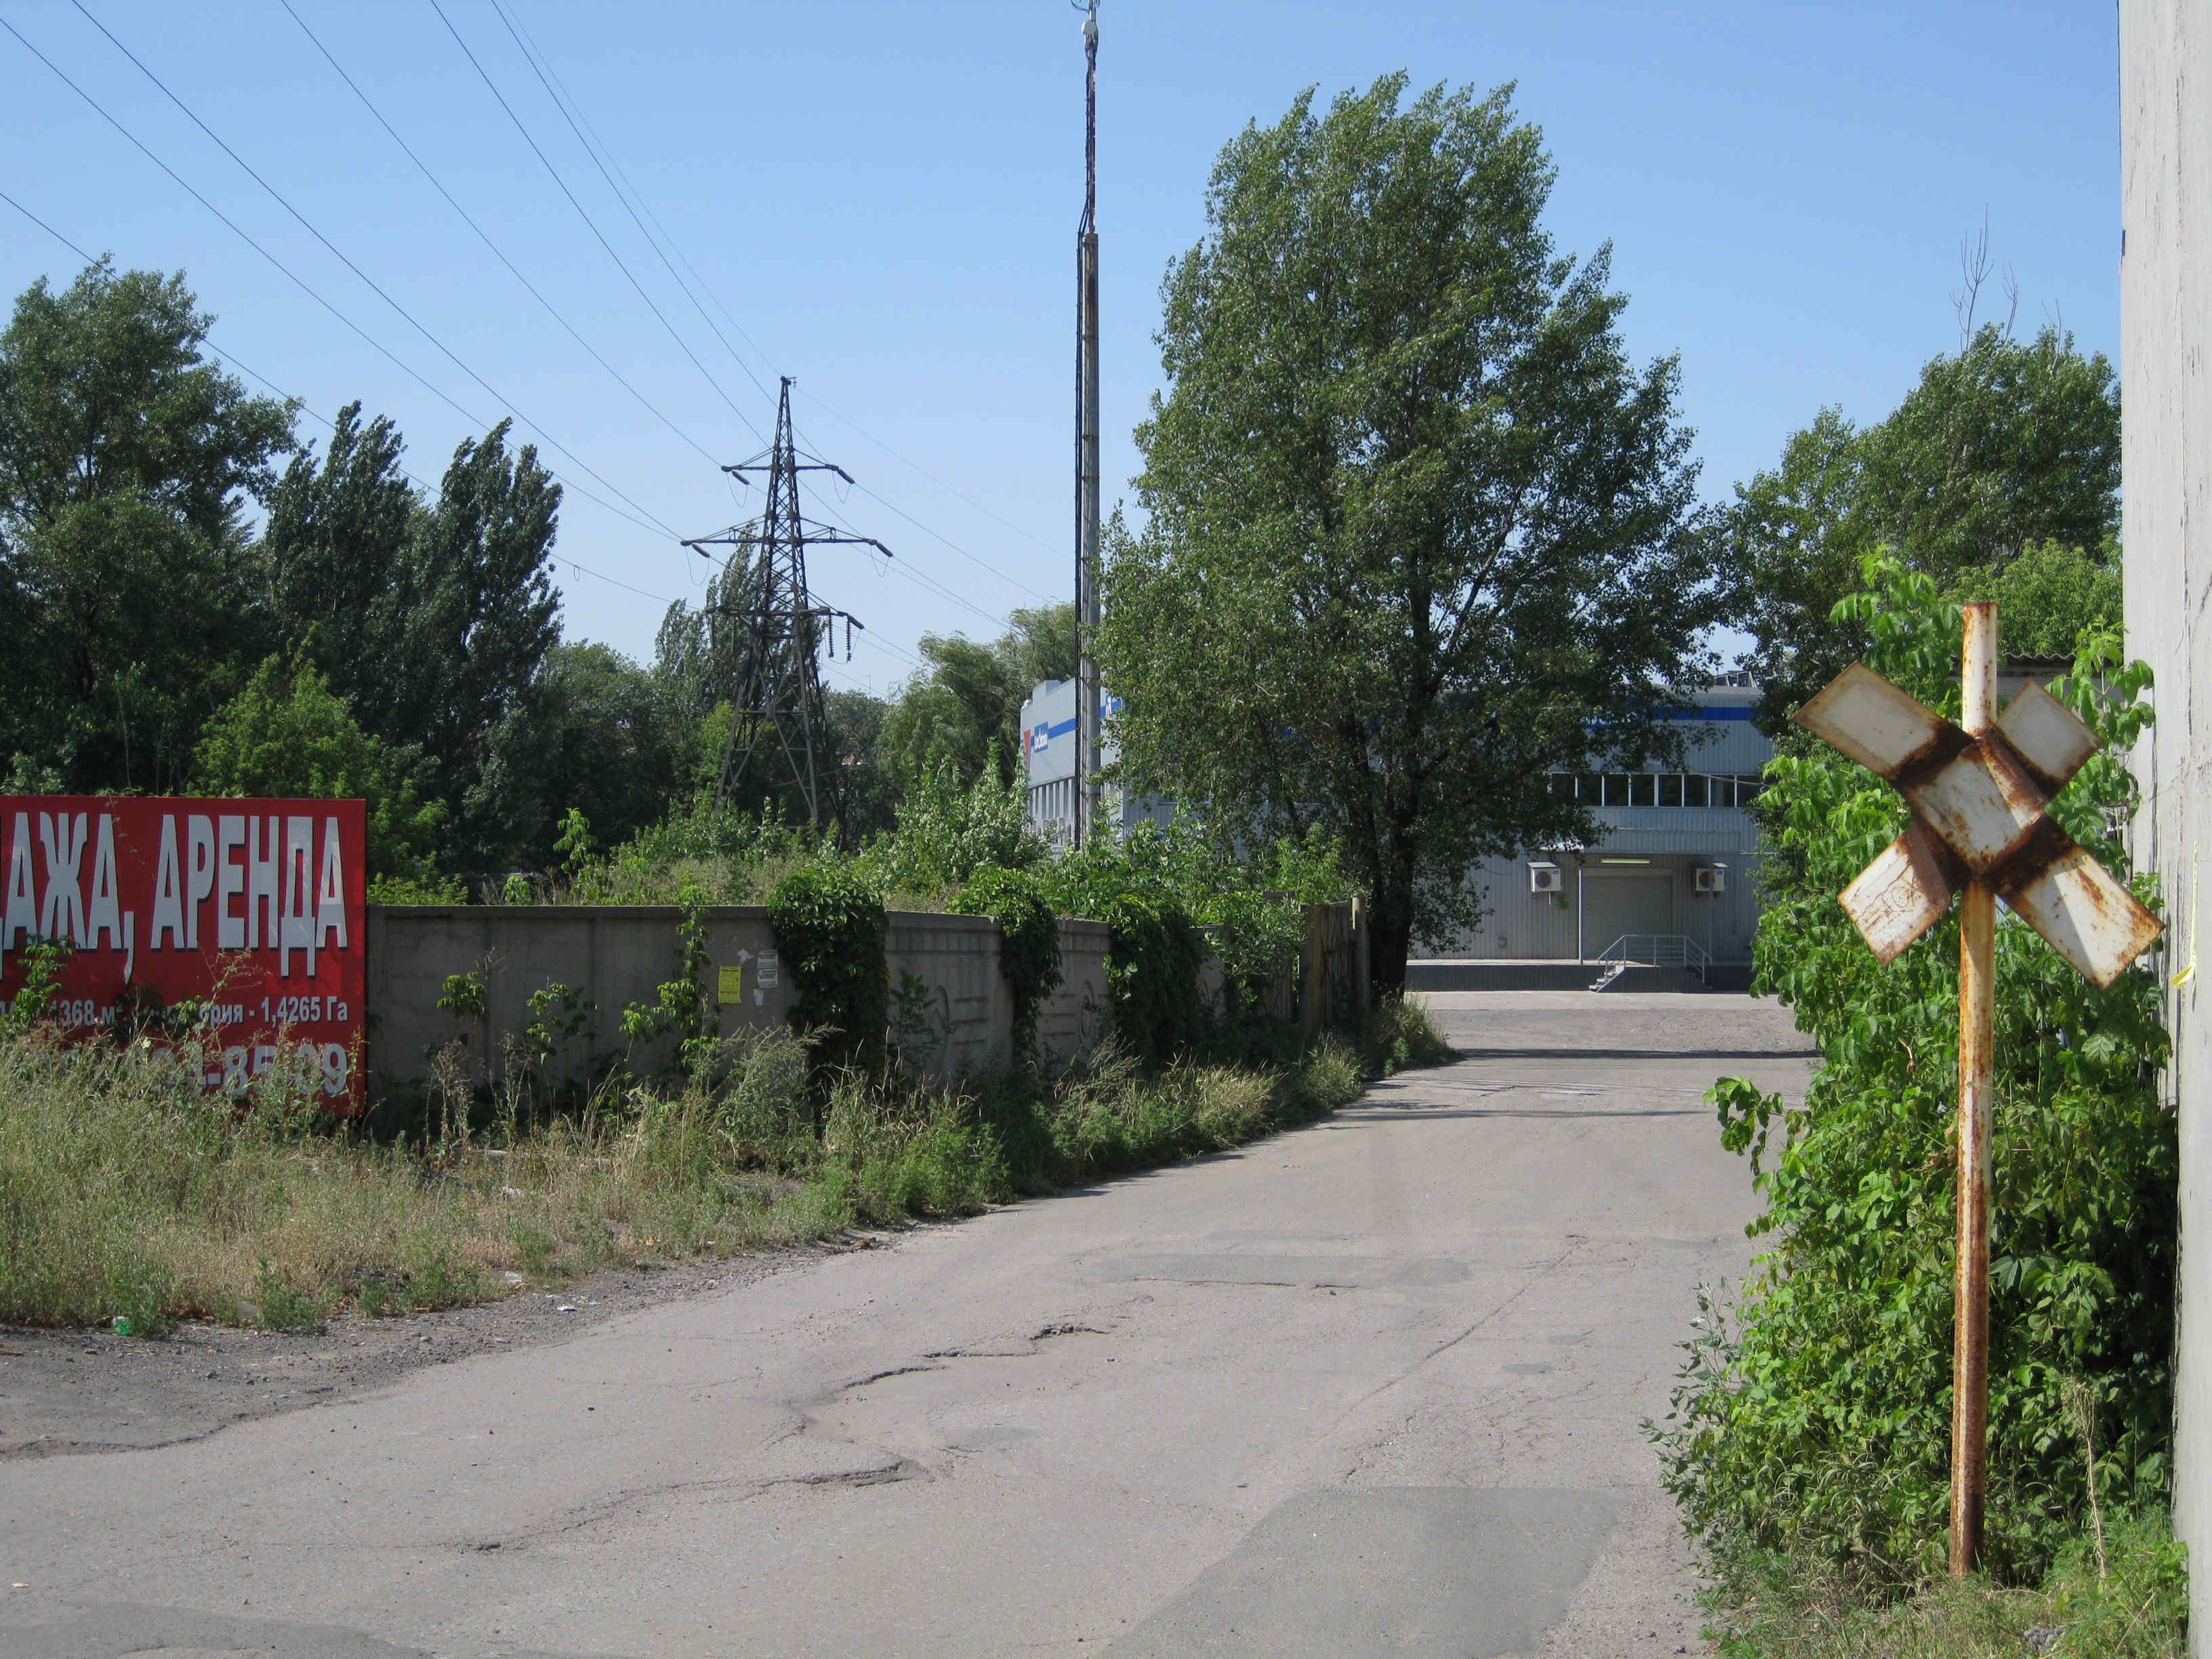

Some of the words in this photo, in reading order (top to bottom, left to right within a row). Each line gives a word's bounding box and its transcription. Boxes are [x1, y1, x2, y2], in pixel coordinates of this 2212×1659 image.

[0, 812, 134, 985] АЖА,
[150, 815, 348, 977] АРЕНДА
[262, 996, 321, 1028] 1,4265
[327, 996, 348, 1021] Га
